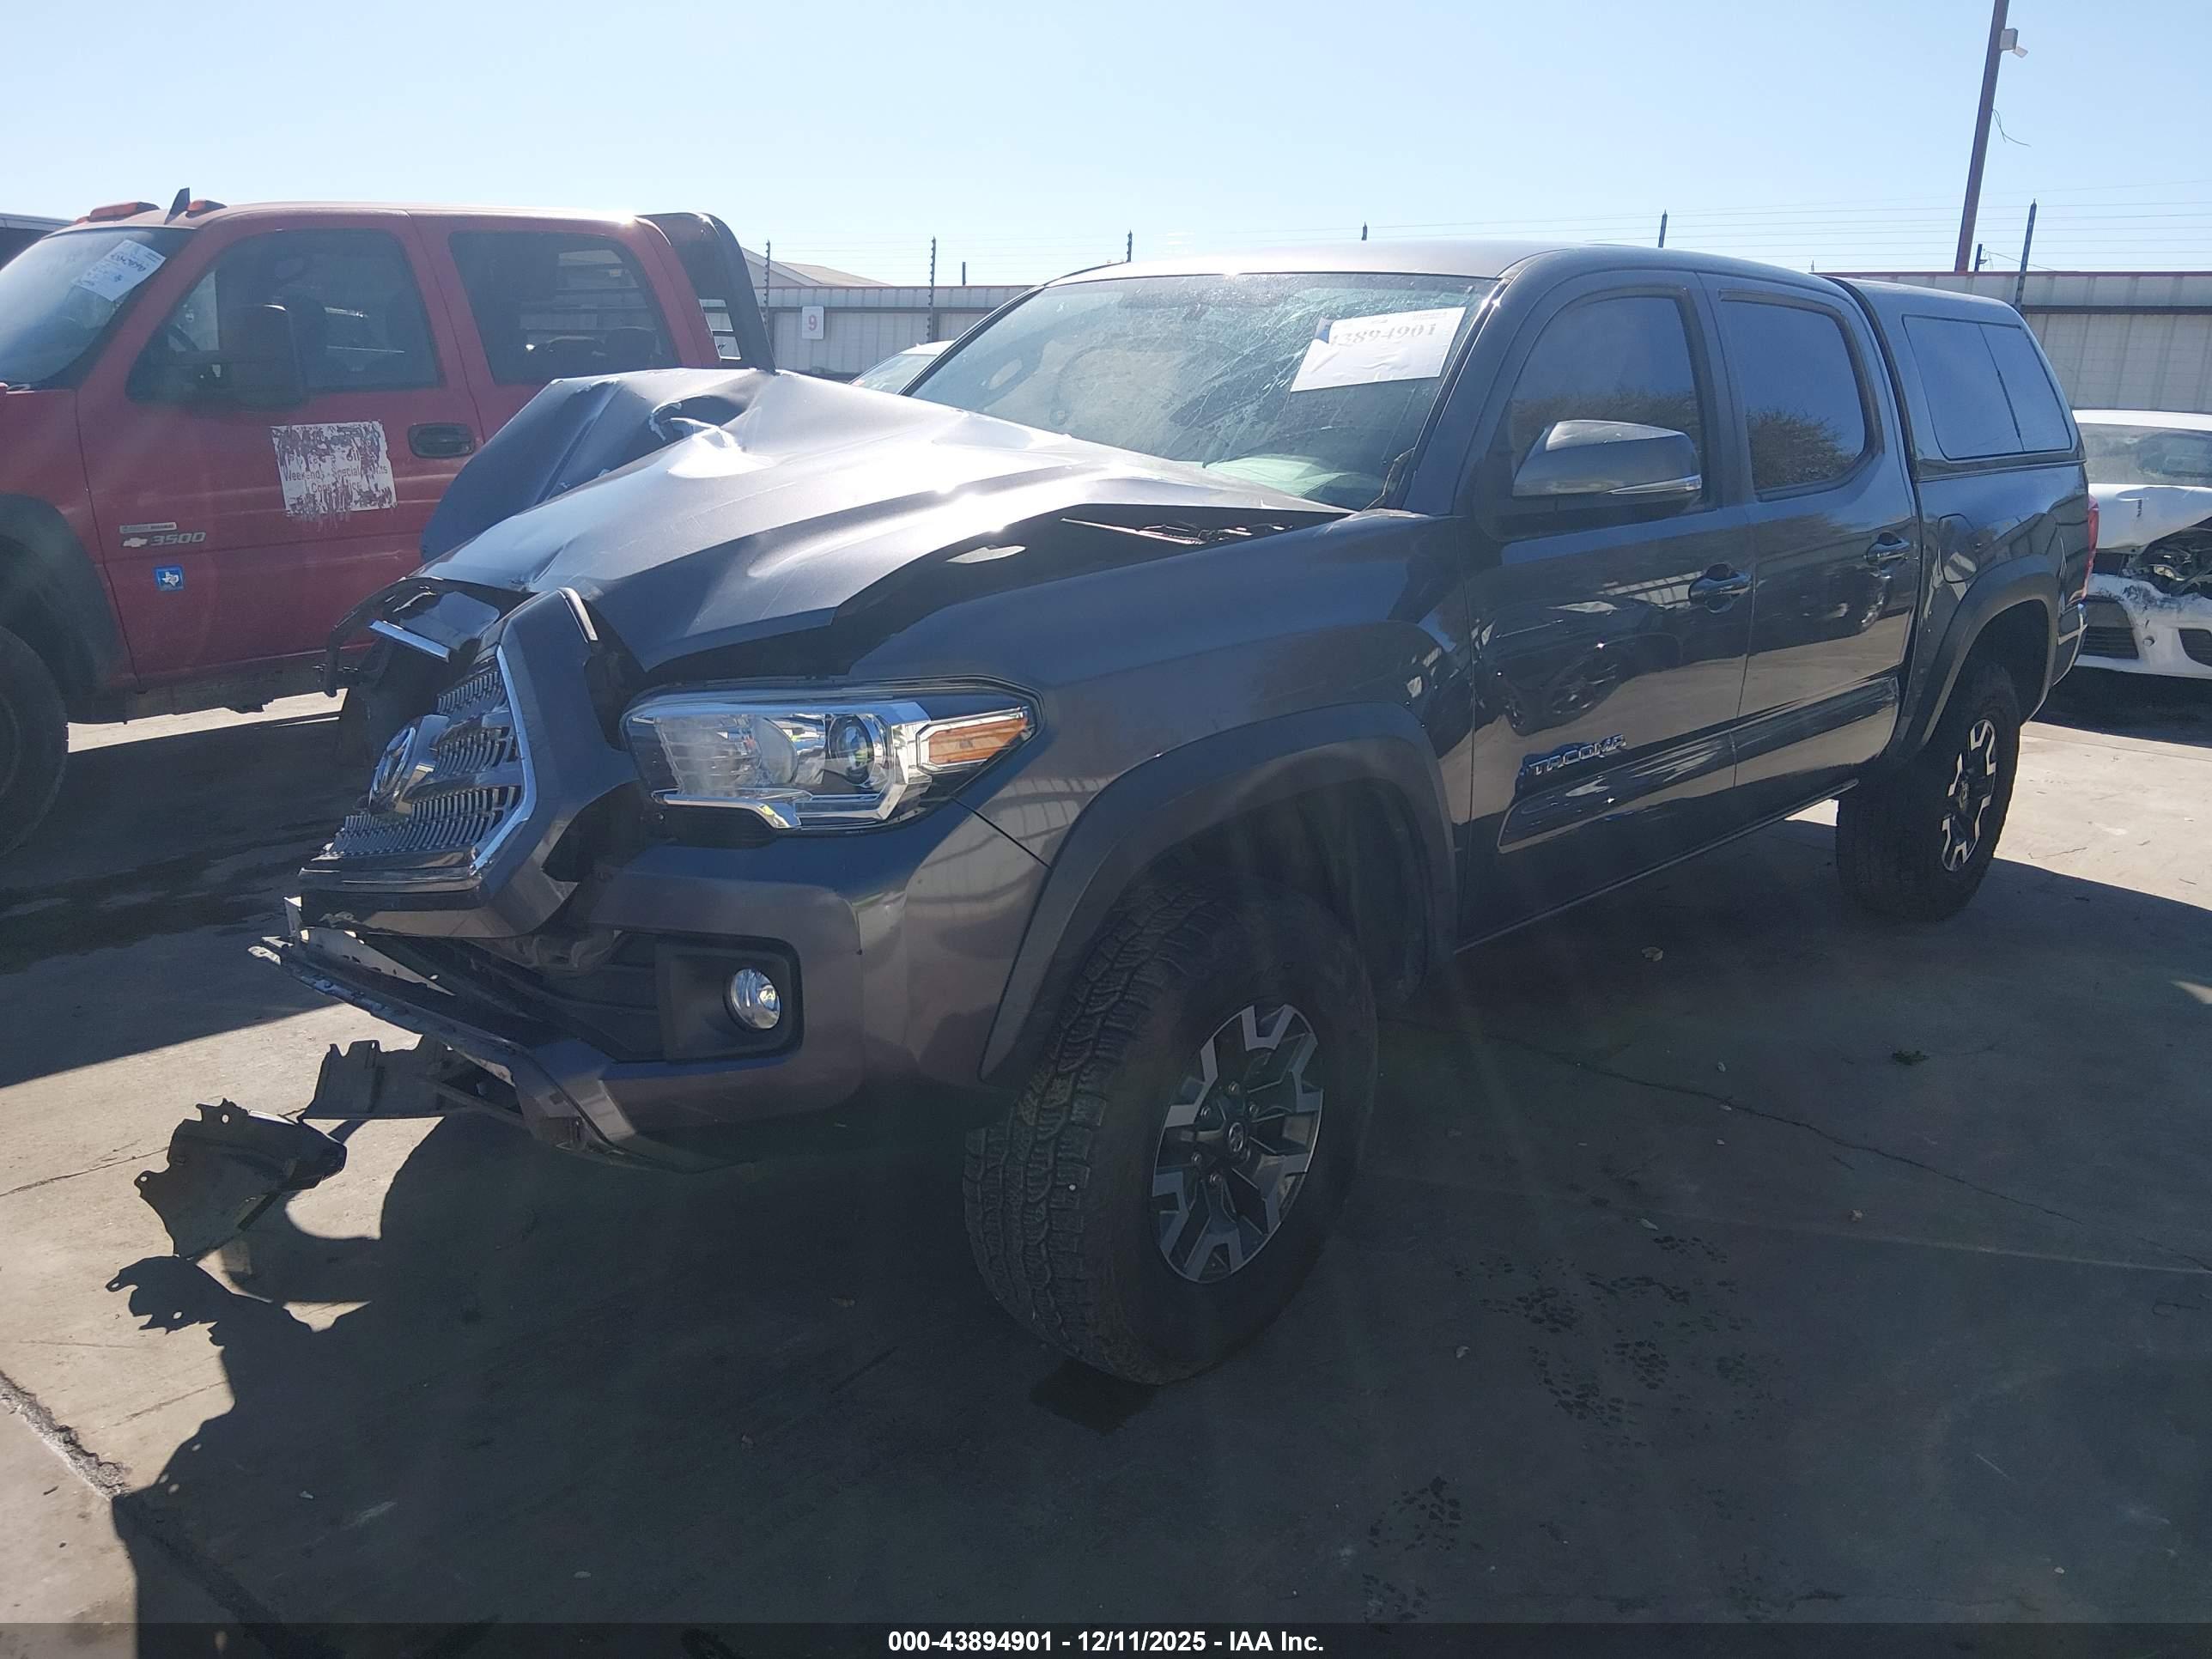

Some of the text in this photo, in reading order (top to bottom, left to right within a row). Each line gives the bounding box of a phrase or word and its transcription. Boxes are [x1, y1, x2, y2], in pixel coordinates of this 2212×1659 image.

[807, 314, 818, 331] 9
[150, 532, 207, 546] 3500
[1528, 734, 1628, 776] TACOMA
